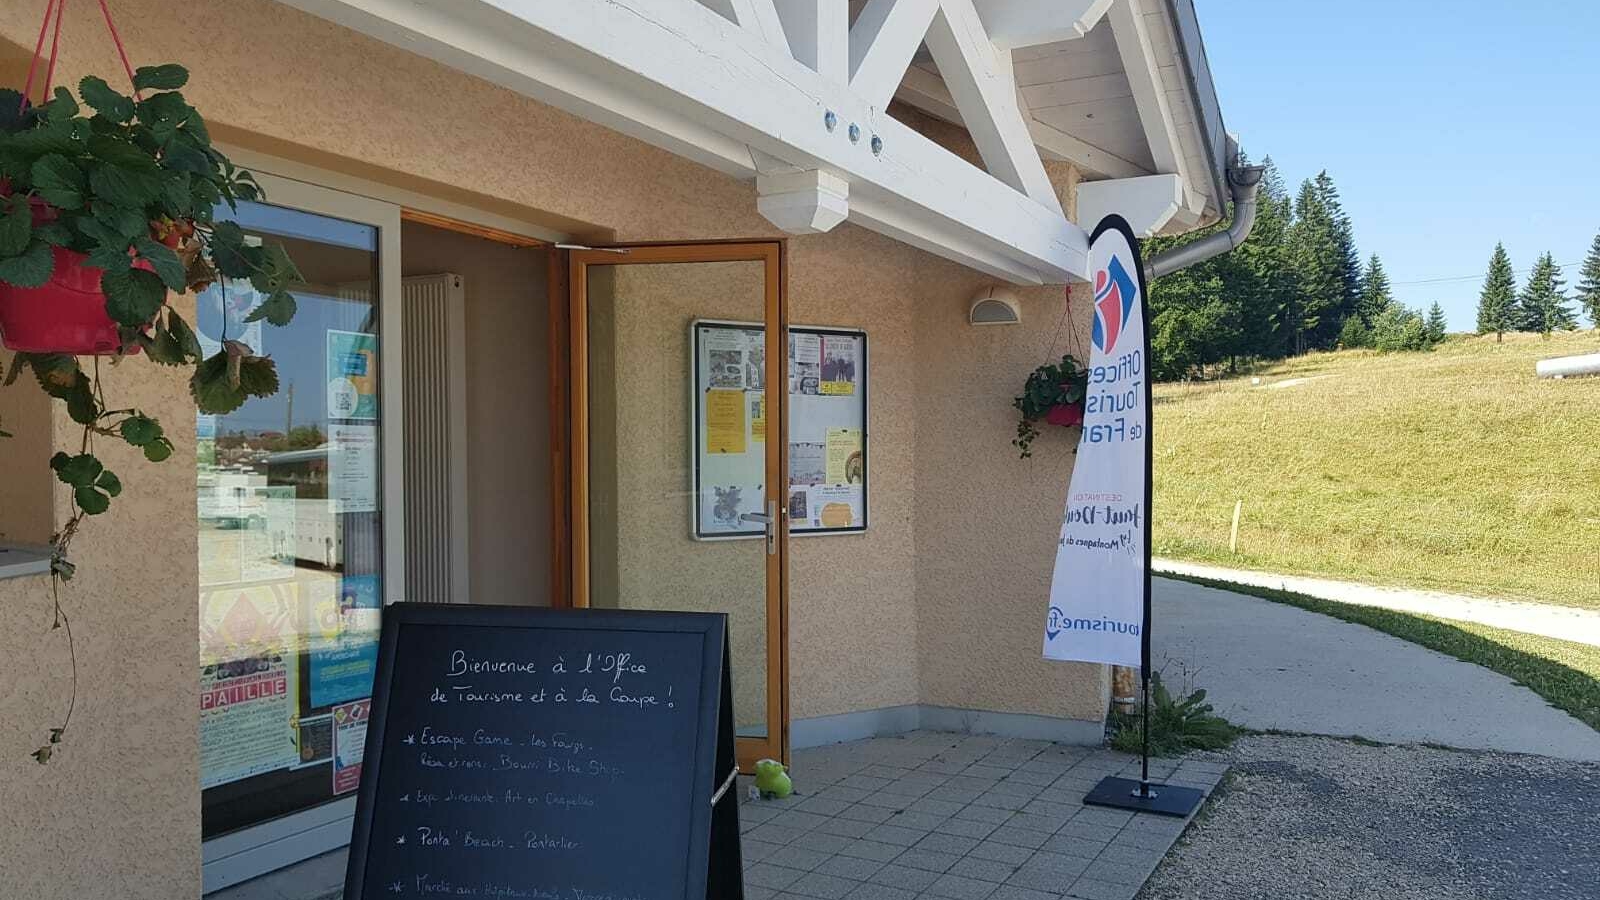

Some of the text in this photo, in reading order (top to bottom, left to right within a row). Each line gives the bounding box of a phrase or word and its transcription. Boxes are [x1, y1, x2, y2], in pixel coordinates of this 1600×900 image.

[447, 650, 647, 683] Bienvenue à l'Office
[202, 680, 285, 708] PAILLE
[430, 688, 448, 702] de
[453, 685, 523, 702] Tourisme
[530, 688, 547, 702] et
[555, 689, 568, 702] à
[576, 689, 600, 703] la
[421, 727, 465, 750] Escape
[473, 729, 513, 746] Game
